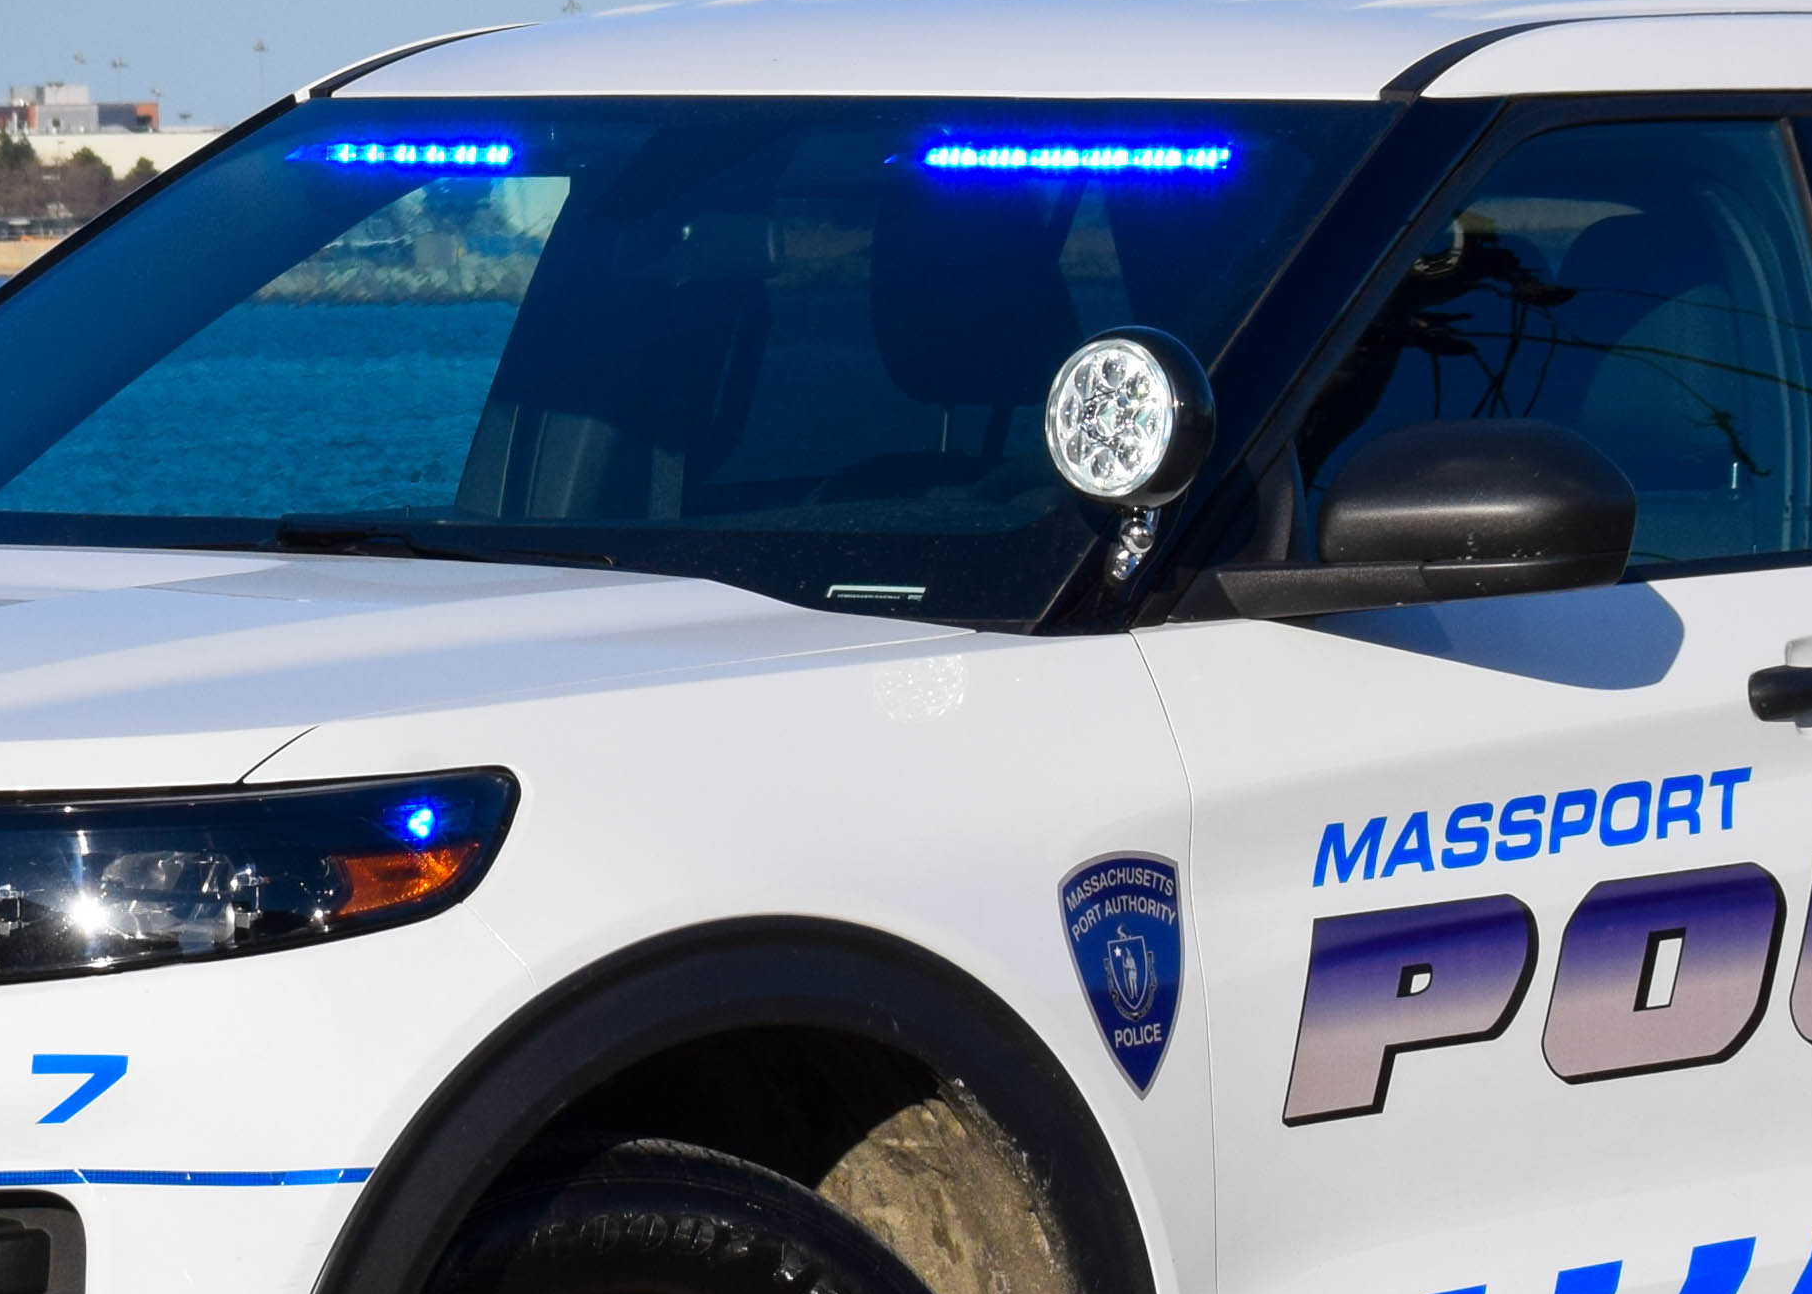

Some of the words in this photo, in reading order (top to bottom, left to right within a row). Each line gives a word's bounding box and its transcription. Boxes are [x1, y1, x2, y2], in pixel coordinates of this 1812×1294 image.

[1312, 766, 1753, 887] MASSPORT
[1065, 867, 1175, 912] MASSACHUSETTS
[1071, 905, 1103, 942] PORT
[1104, 895, 1178, 926] AUTHORITY
[1114, 1023, 1163, 1048] POLICE
[30, 1053, 129, 1125] 7
